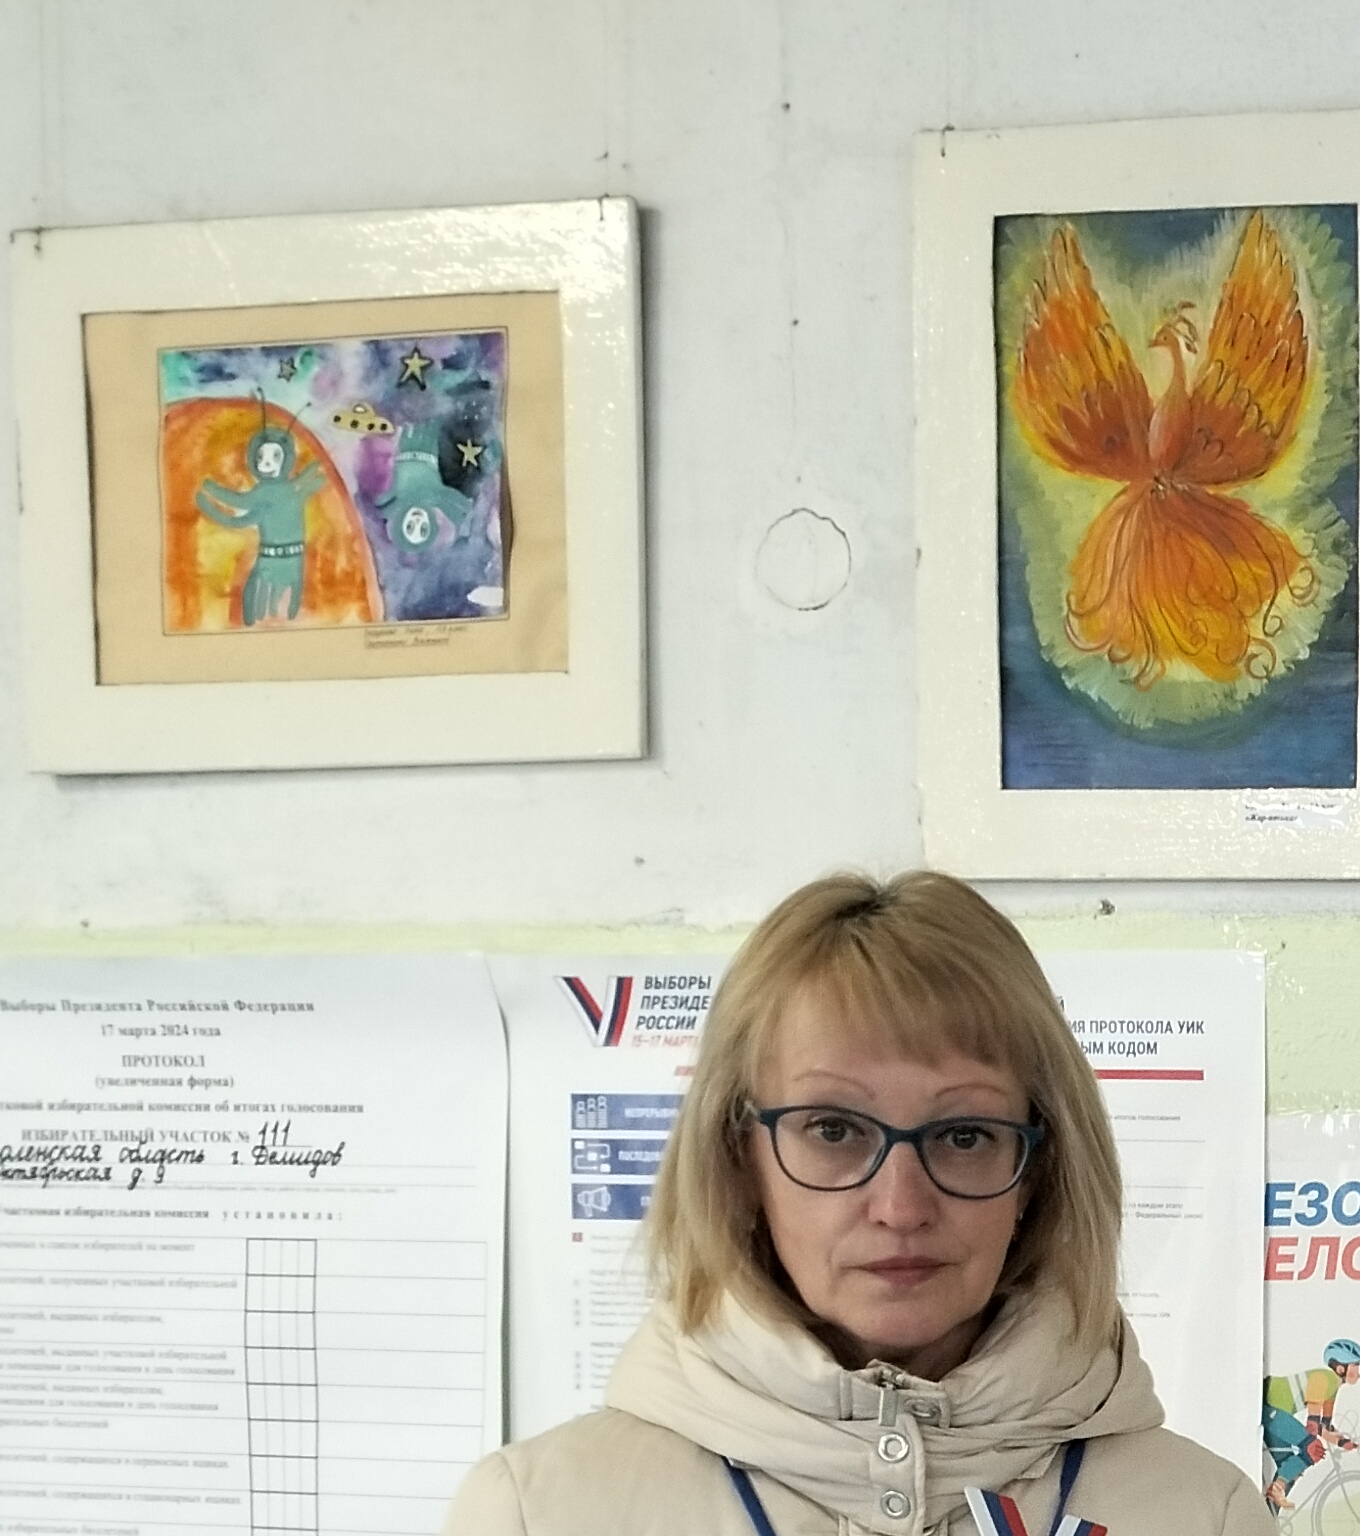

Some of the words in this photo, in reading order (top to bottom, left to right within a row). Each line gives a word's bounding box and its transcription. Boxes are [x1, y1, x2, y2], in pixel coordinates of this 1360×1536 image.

[643, 975, 712, 990] ВЫБОРЫ
[61, 1000, 142, 1015] Президента
[147, 1000, 230, 1013] Российской
[234, 1000, 315, 1014] Федерации
[635, 1015, 698, 1031] РОССИИ
[1089, 1020, 1174, 1034] ПРОТОКОЛА
[1177, 1020, 1205, 1035] УИК
[101, 1024, 115, 1037] 17
[118, 1026, 157, 1040] марта
[160, 1025, 190, 1037] 2024
[193, 1027, 222, 1038] года
[1107, 1041, 1158, 1058] КОДОМ
[121, 1055, 206, 1069] ПРОТОКОЛ
[95, 1076, 183, 1090] (увеличенная
[186, 1076, 236, 1090] форма)
[280, 1104, 364, 1115] голосования
[21, 1129, 155, 1144] ИЗБИРАТЕЛЬНЫЙ
[159, 1129, 232, 1144] УЧАСТОК
[257, 1119, 292, 1148] 111
